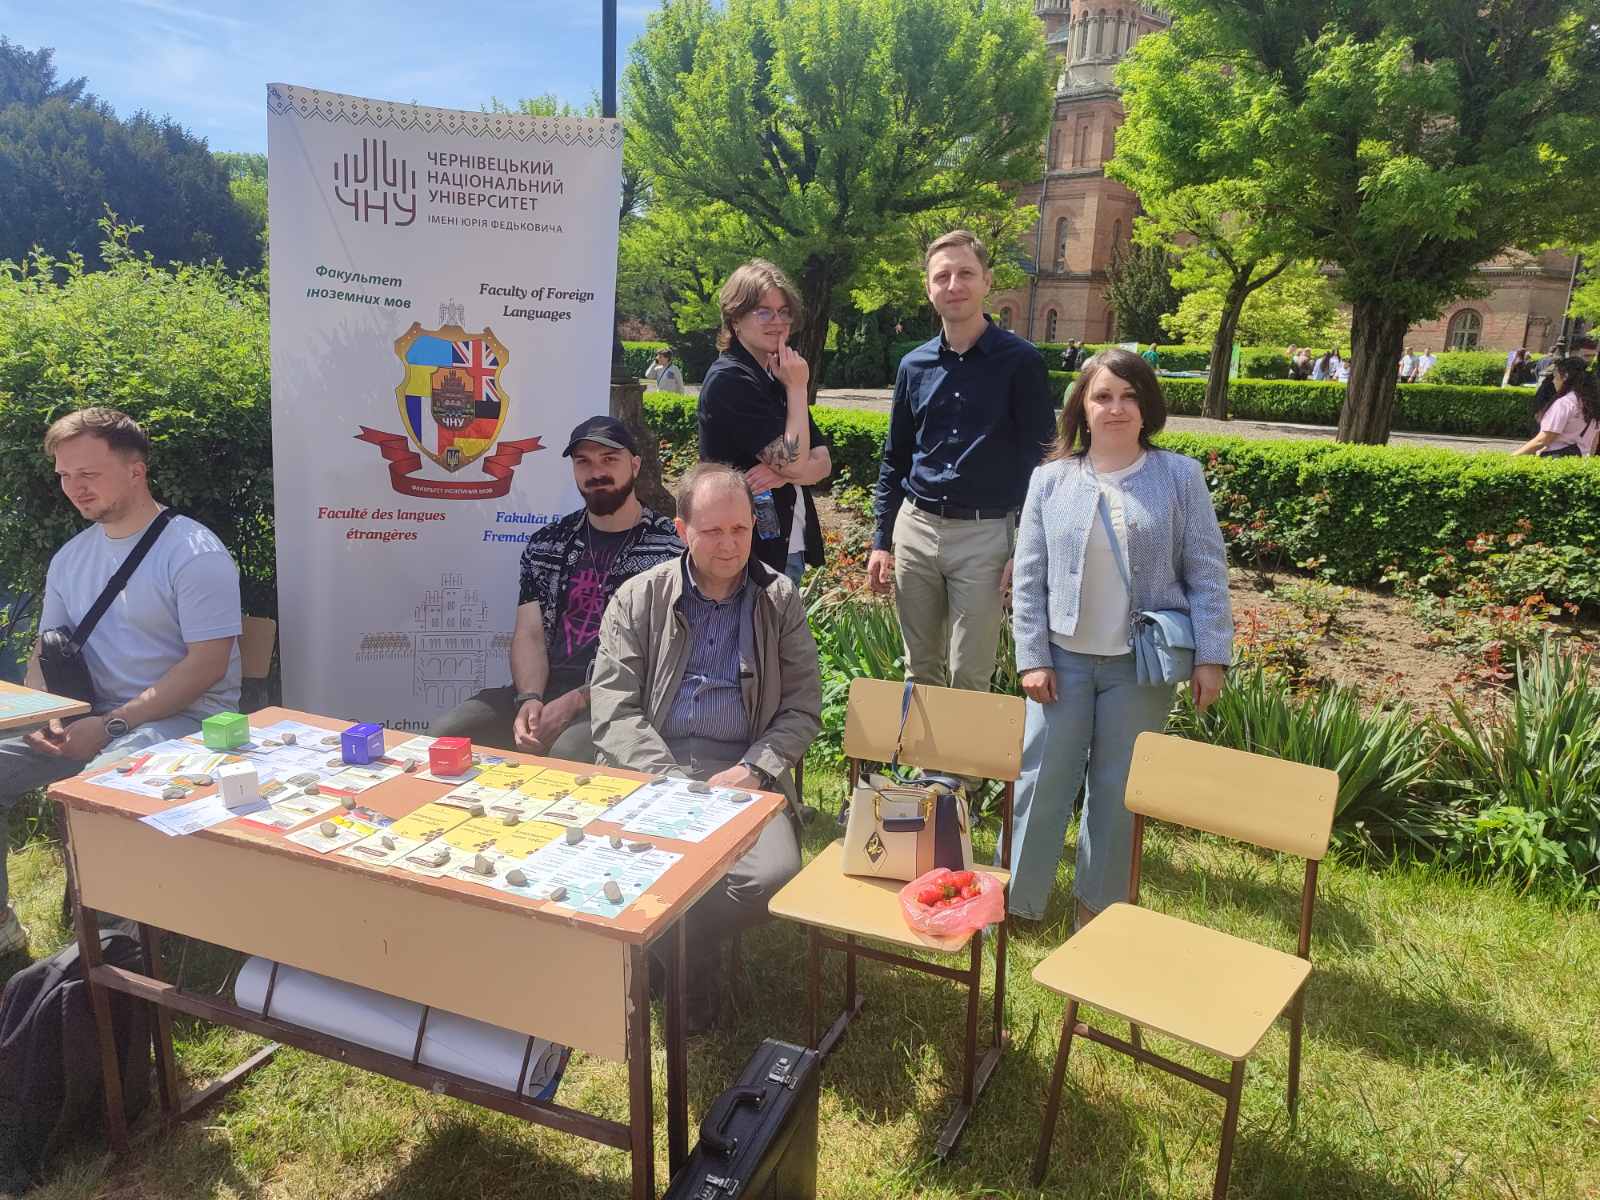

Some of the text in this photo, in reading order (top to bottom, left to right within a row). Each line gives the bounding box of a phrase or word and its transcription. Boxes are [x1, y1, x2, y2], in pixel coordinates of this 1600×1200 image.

[427, 151, 554, 175] ЧЕРНІВЕЦЬКИЙ
[427, 170, 564, 195] НАЦІОНАЛЬНИЙ
[428, 189, 539, 211] УНІВЕРСИТЕТ
[428, 215, 564, 234] ІМЕНІ ЮРІЯ ФЕДЬКОВИЧА
[315, 265, 403, 288] Факультет
[383, 297, 412, 309] мов
[479, 283, 595, 304] Faculty of Foreign
[503, 304, 573, 322] Languages
[317, 506, 447, 523] Faculté des langues
[346, 527, 418, 543] étrangères
